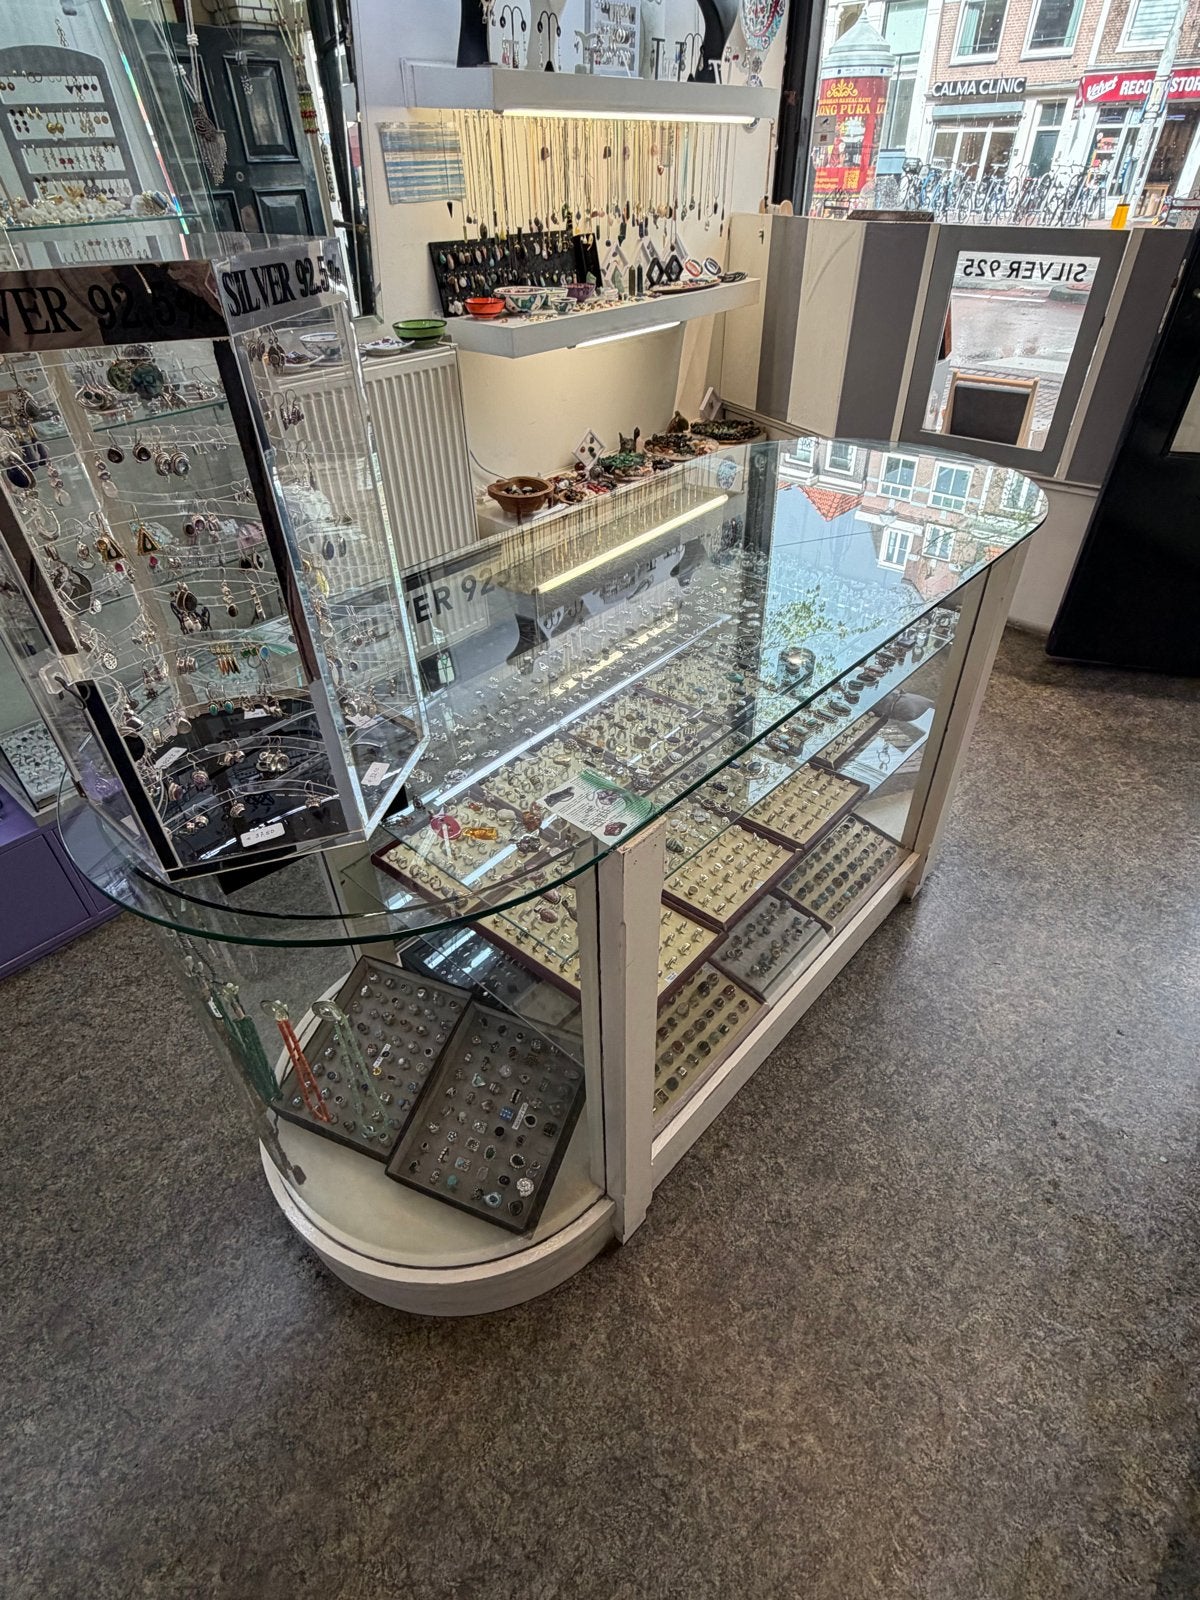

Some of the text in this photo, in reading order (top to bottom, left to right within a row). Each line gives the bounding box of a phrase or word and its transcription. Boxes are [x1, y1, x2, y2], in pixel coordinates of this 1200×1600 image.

[932, 77, 1025, 97] CALMA CLINIC
[1120, 78, 1163, 96] RECO
[839, 103, 871, 115] PURA
[221, 262, 297, 317] SILVER
[406, 585, 453, 625] ER
